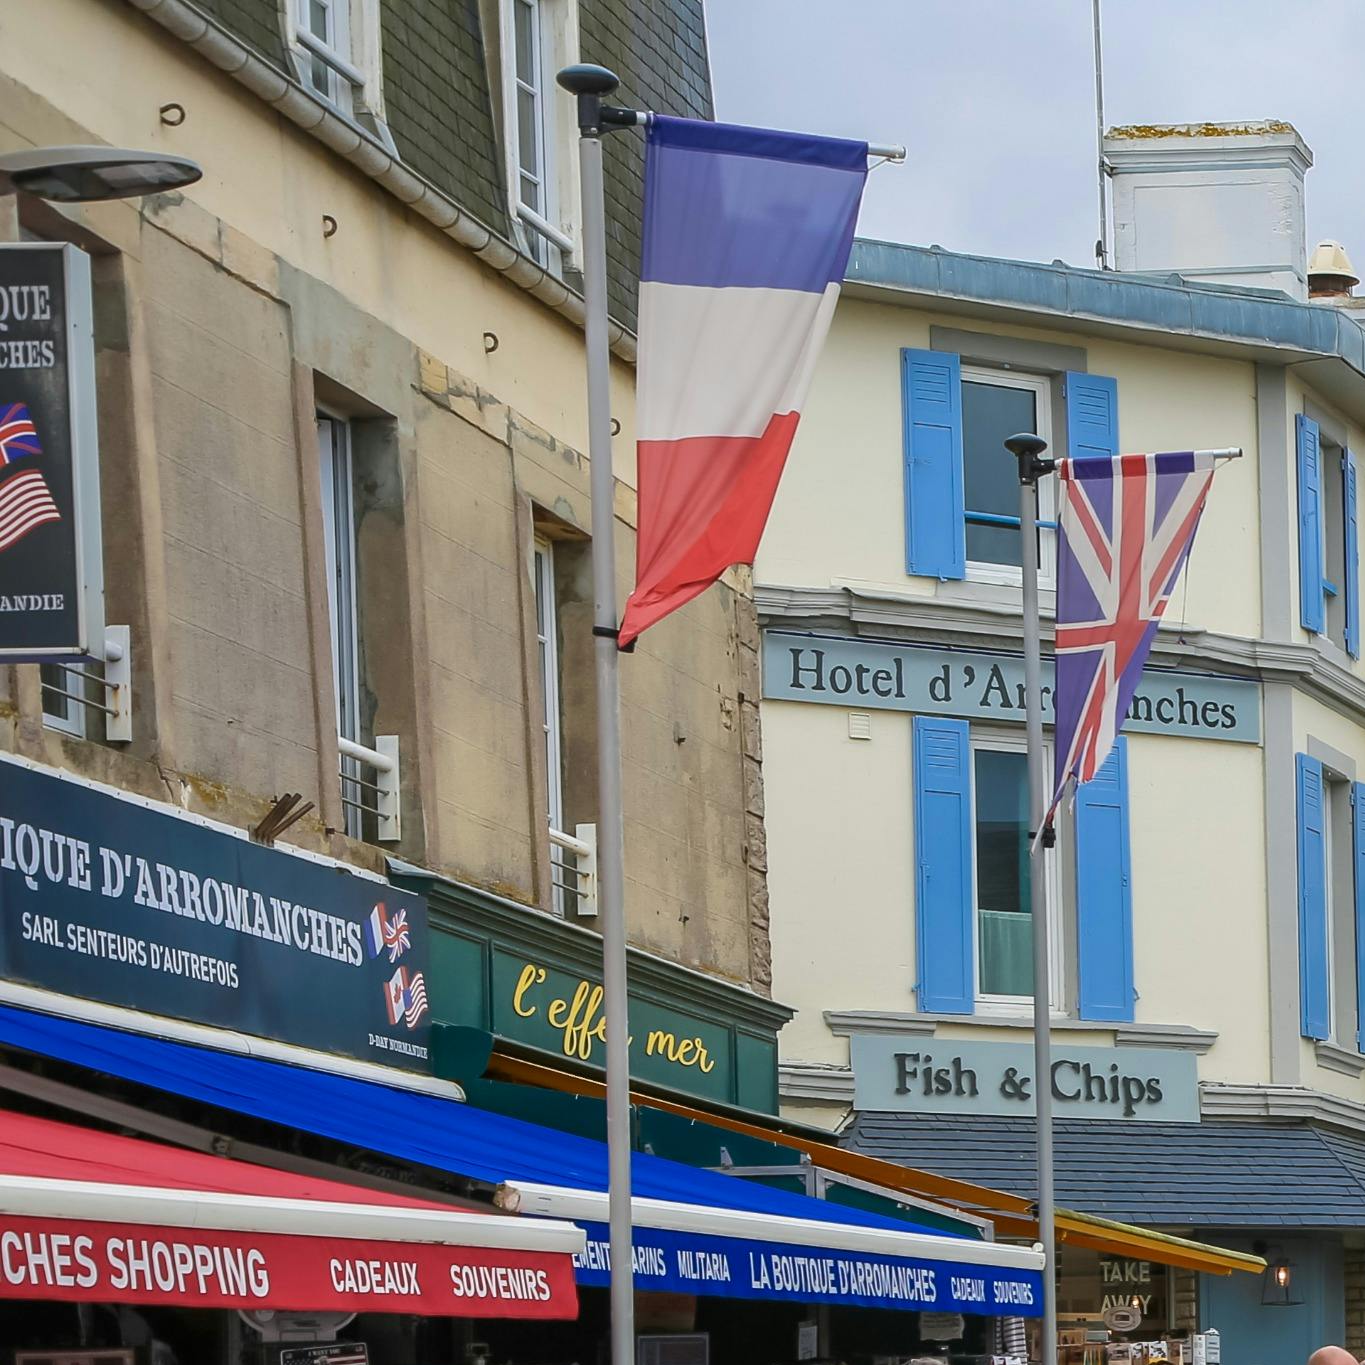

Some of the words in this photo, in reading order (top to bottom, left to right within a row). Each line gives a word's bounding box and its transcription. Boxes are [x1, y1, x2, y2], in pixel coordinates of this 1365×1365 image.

[789, 649, 907, 698] Hotel
[0, 817, 92, 891] IQUE
[99, 847, 364, 967] D'ARROMANCHES
[22, 912, 64, 948] SARL
[67, 923, 147, 967] SENTEURS
[150, 943, 239, 989] D'AUTREFOIS
[368, 1033, 388, 1049] D-DAY
[389, 1038, 428, 1059] NORMANDIE
[646, 1030, 715, 1073] mer
[895, 1052, 978, 1098] Fish
[1000, 1067, 1031, 1101] &
[1049, 1059, 1163, 1117] Chips
[1, 1231, 97, 1289] CHES
[105, 1237, 269, 1298] SHOPPING
[329, 1257, 421, 1296] CADEAUX
[450, 1264, 550, 1301] SOUVENIRS
[677, 1250, 731, 1281] MILITARIA
[750, 1252, 771, 1289] LA
[773, 1254, 837, 1294] BOUTIQUE
[839, 1260, 936, 1303] D'ARROMANCHES
[951, 1277, 985, 1302] CADEAUX
[994, 1280, 1033, 1305] SOUVENIRS
[1100, 1261, 1152, 1282] TAKE
[1101, 1295, 1152, 1315] AWY
